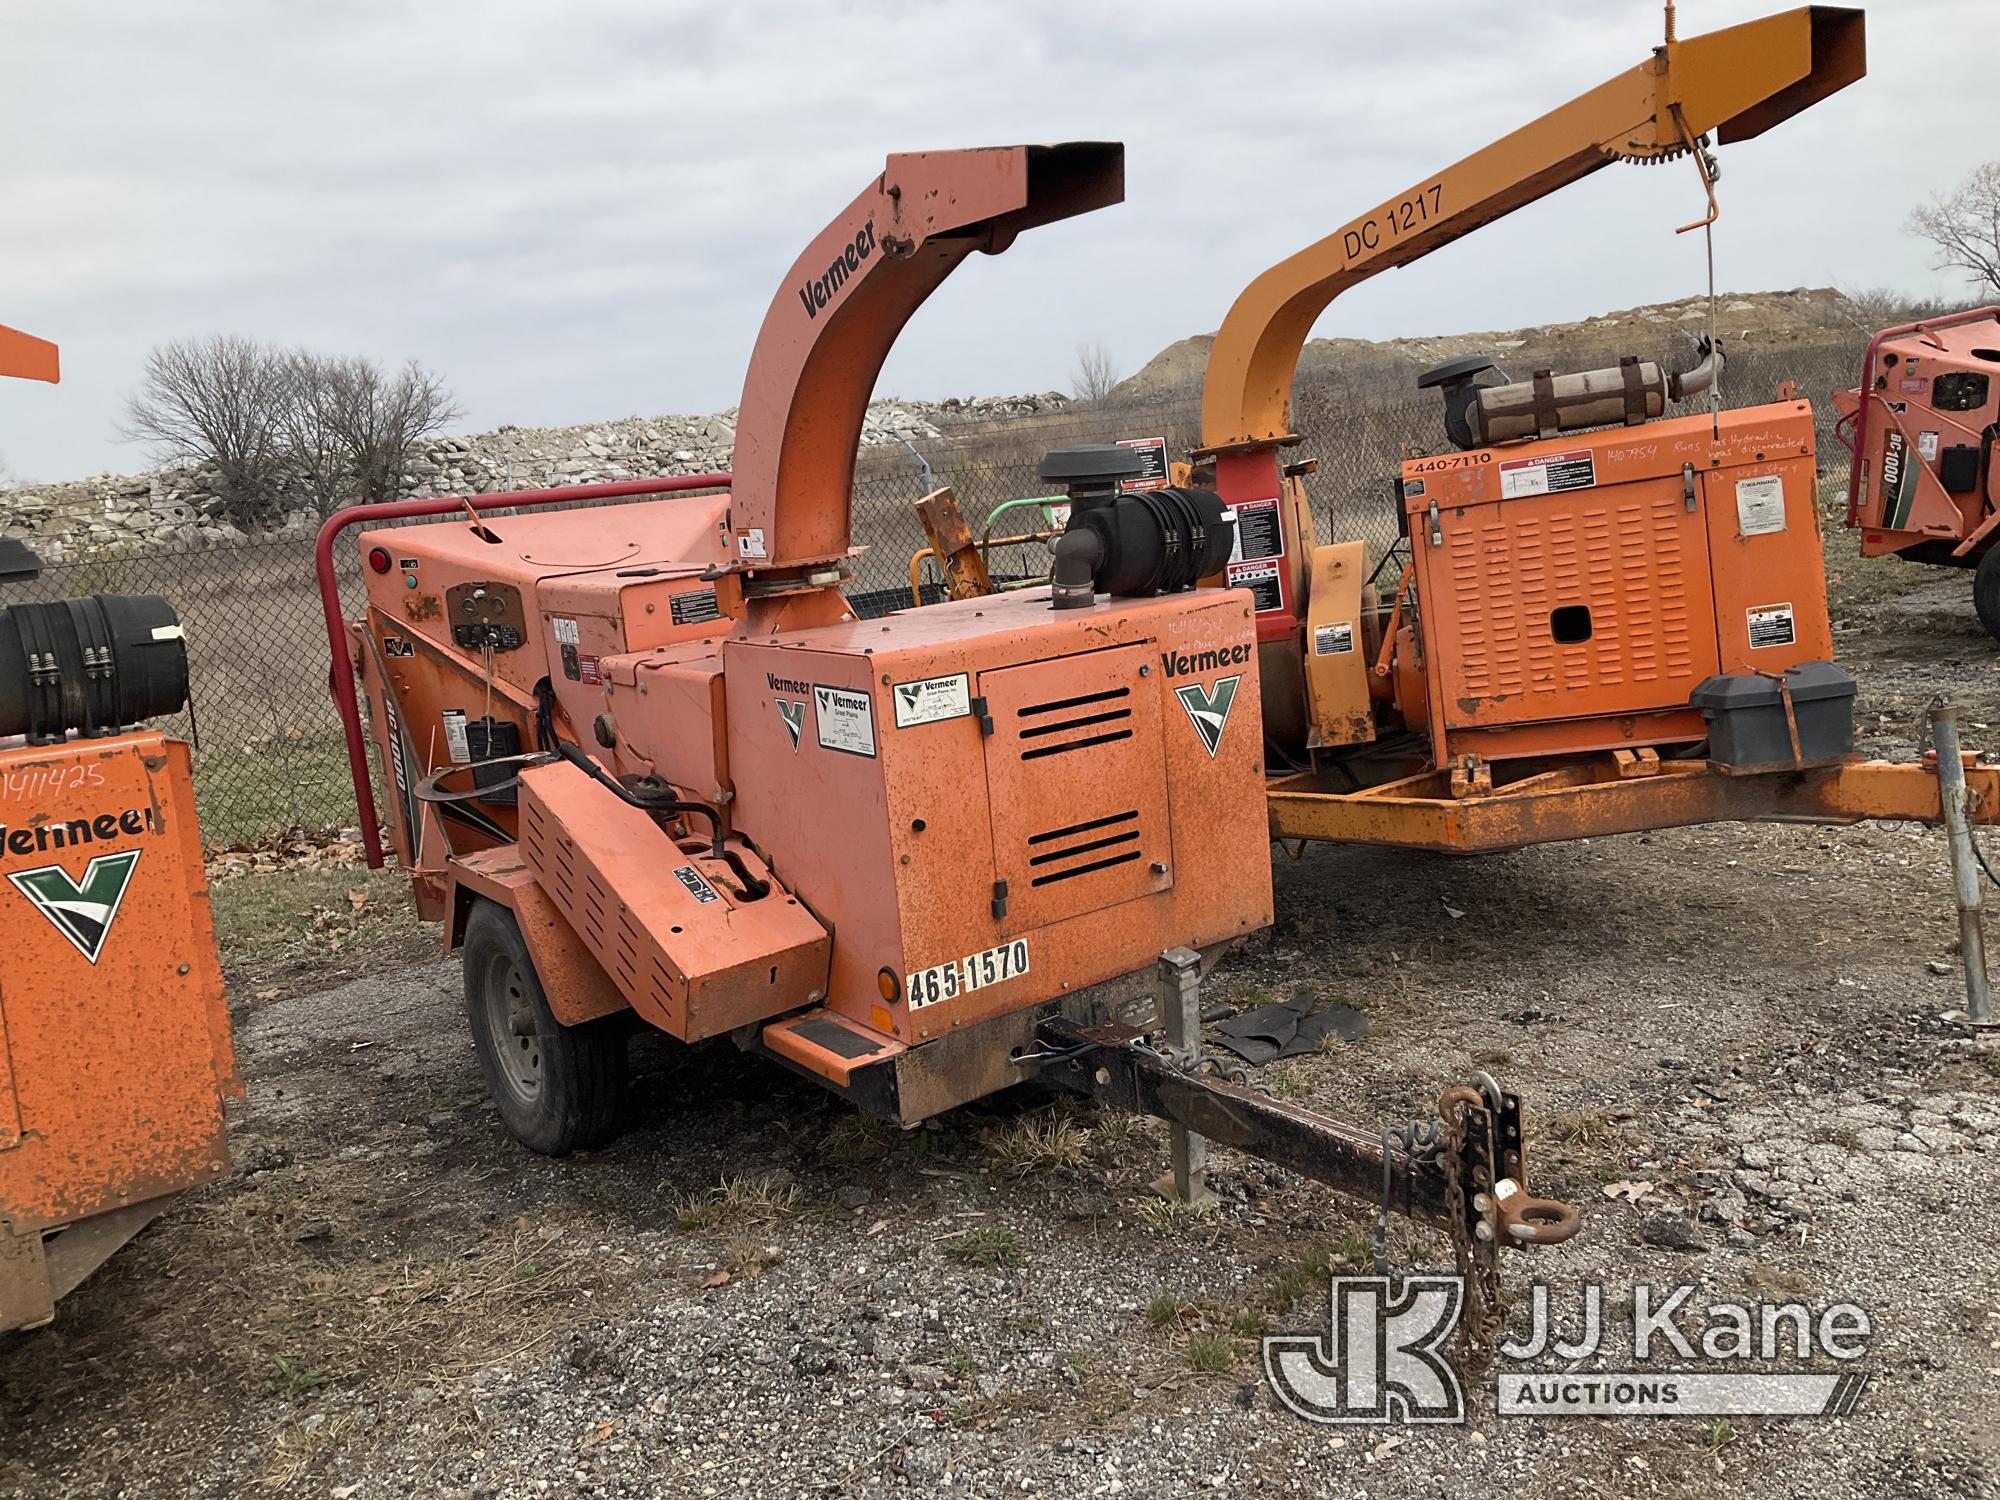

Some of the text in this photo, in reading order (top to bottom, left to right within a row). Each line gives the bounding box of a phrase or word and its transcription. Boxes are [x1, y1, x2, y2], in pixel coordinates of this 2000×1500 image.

[1344, 184, 1442, 260] DC 1217
[799, 219, 876, 320] Vermeer
[1415, 453, 1492, 473] 440-7110
[1534, 456, 1565, 465] DANGER
[1249, 501, 1272, 509] DANGER
[1242, 563, 1268, 572] DANGER
[1161, 643, 1252, 678] Vermeer
[767, 672, 810, 695] Vermeer
[924, 680, 958, 691] Vermeer
[832, 692, 867, 712] Vermeer
[3, 763, 105, 802] 1411425
[911, 941, 1027, 1007] 465-1570
